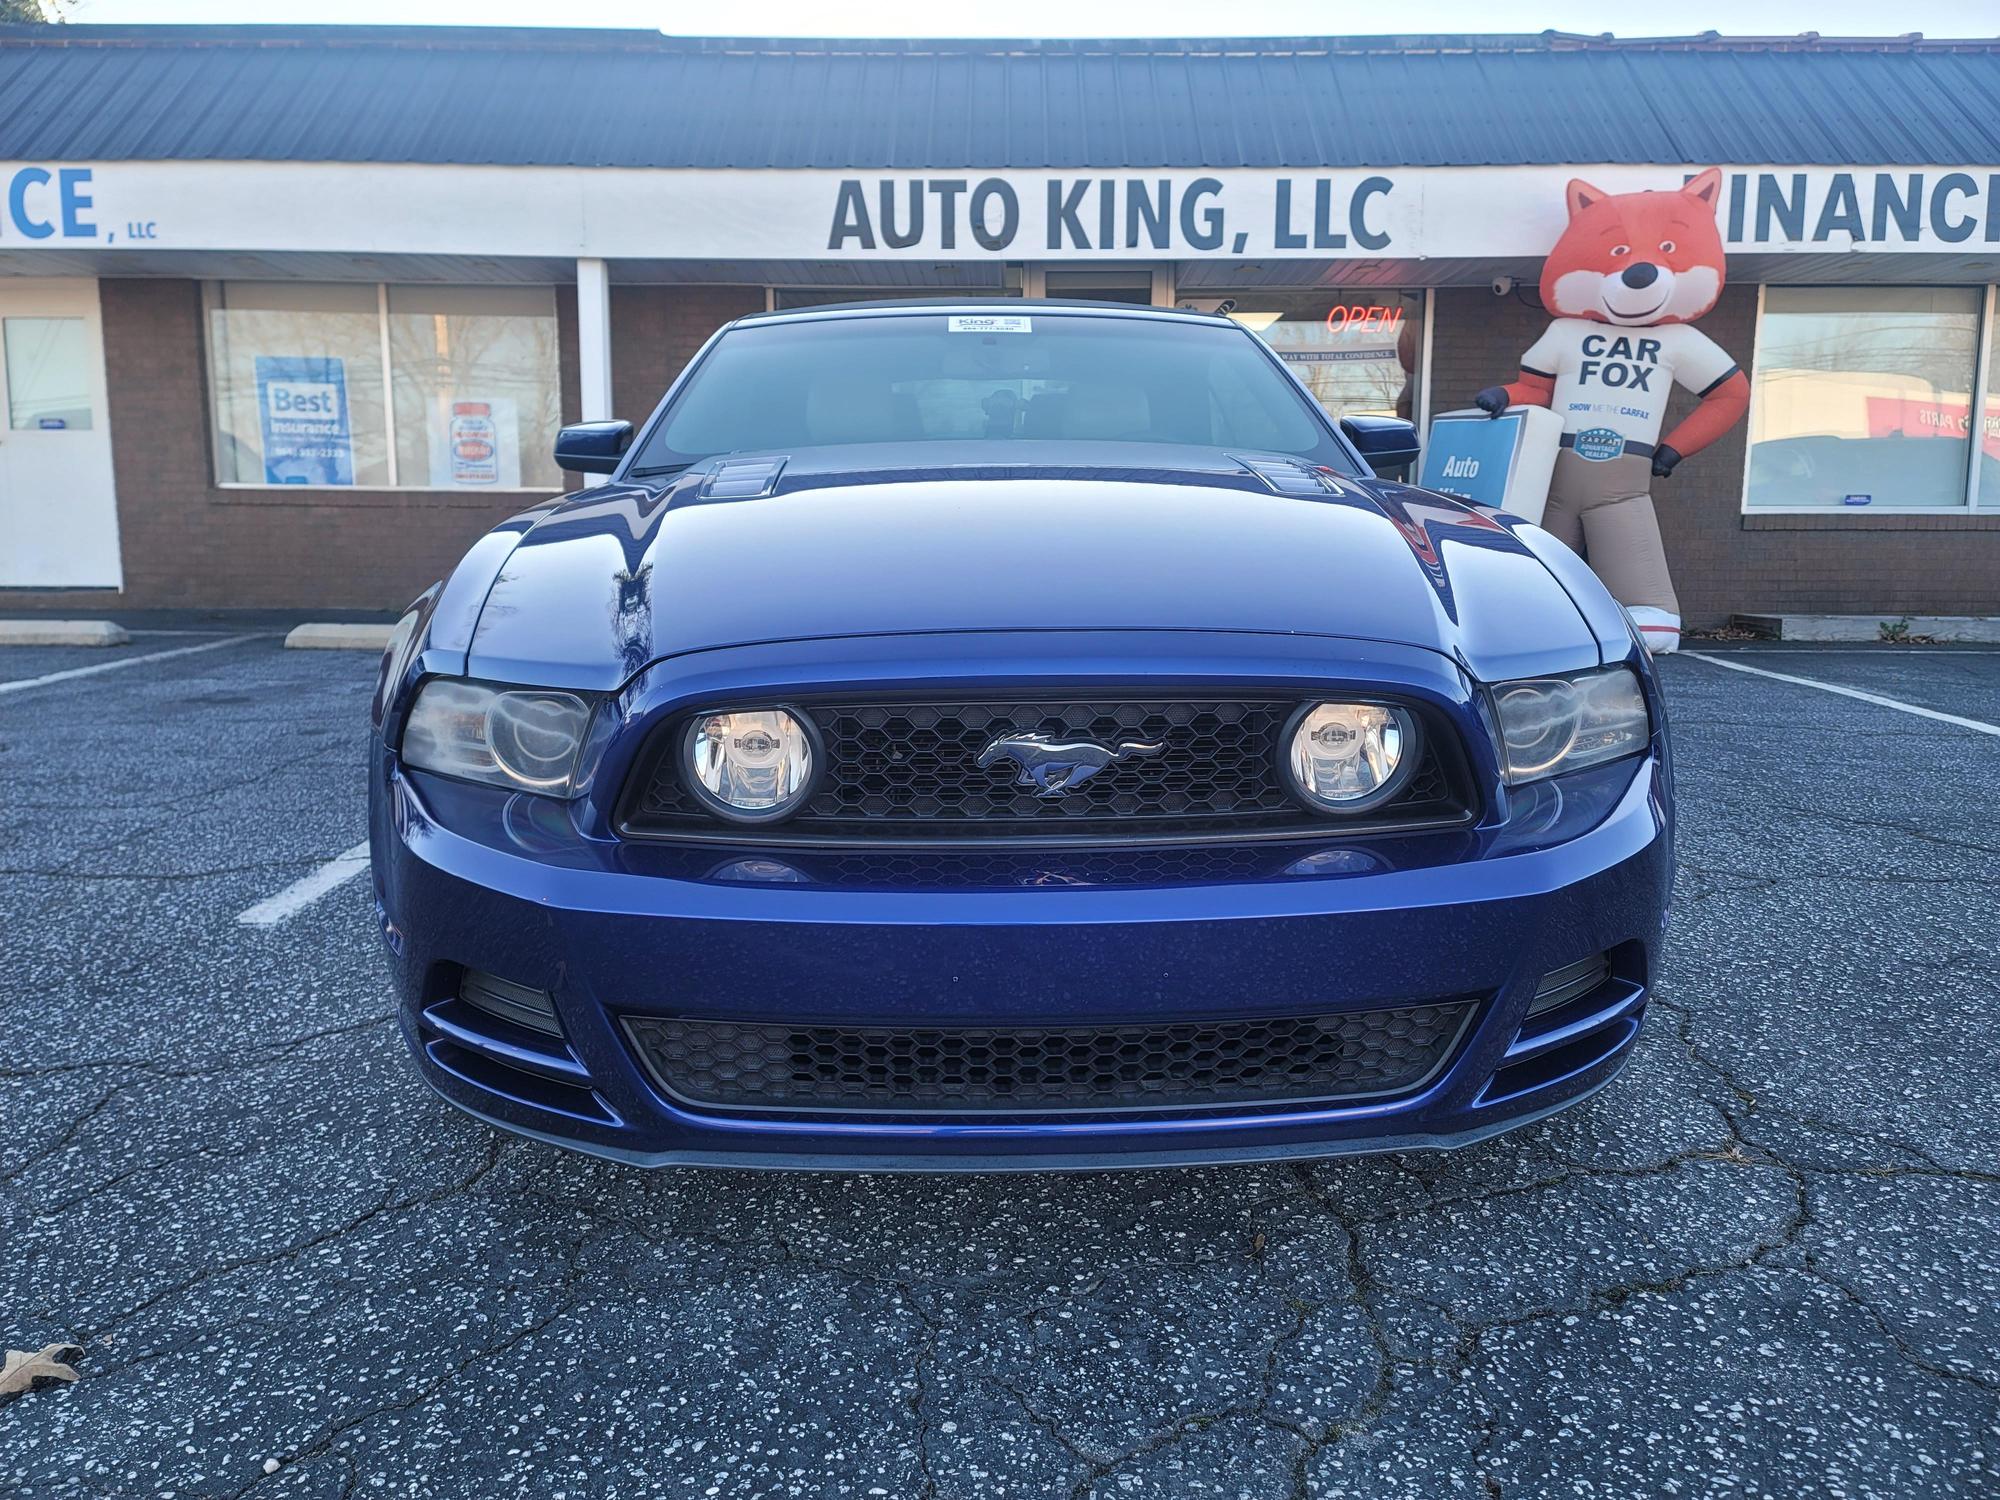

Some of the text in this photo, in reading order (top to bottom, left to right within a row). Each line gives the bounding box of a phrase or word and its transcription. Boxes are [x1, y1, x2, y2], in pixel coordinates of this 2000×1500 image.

[827, 175, 1395, 254] AUTO KING, LLC
[1683, 172, 2000, 243] INANC
[128, 222, 157, 239] LLC
[1327, 305, 1403, 334] OPEN
[1281, 353, 1298, 361] WAY
[1300, 353, 1319, 361] WITH
[1322, 352, 1343, 360] TOTAL
[1581, 334, 1662, 365] CAR
[1578, 360, 1654, 393] FOX
[274, 387, 333, 413] Best
[1568, 402, 1592, 412] SHOW
[1620, 406, 1650, 420] CARFAX
[1442, 455, 1480, 478] Auto
[1584, 450, 1609, 459] DEALER
